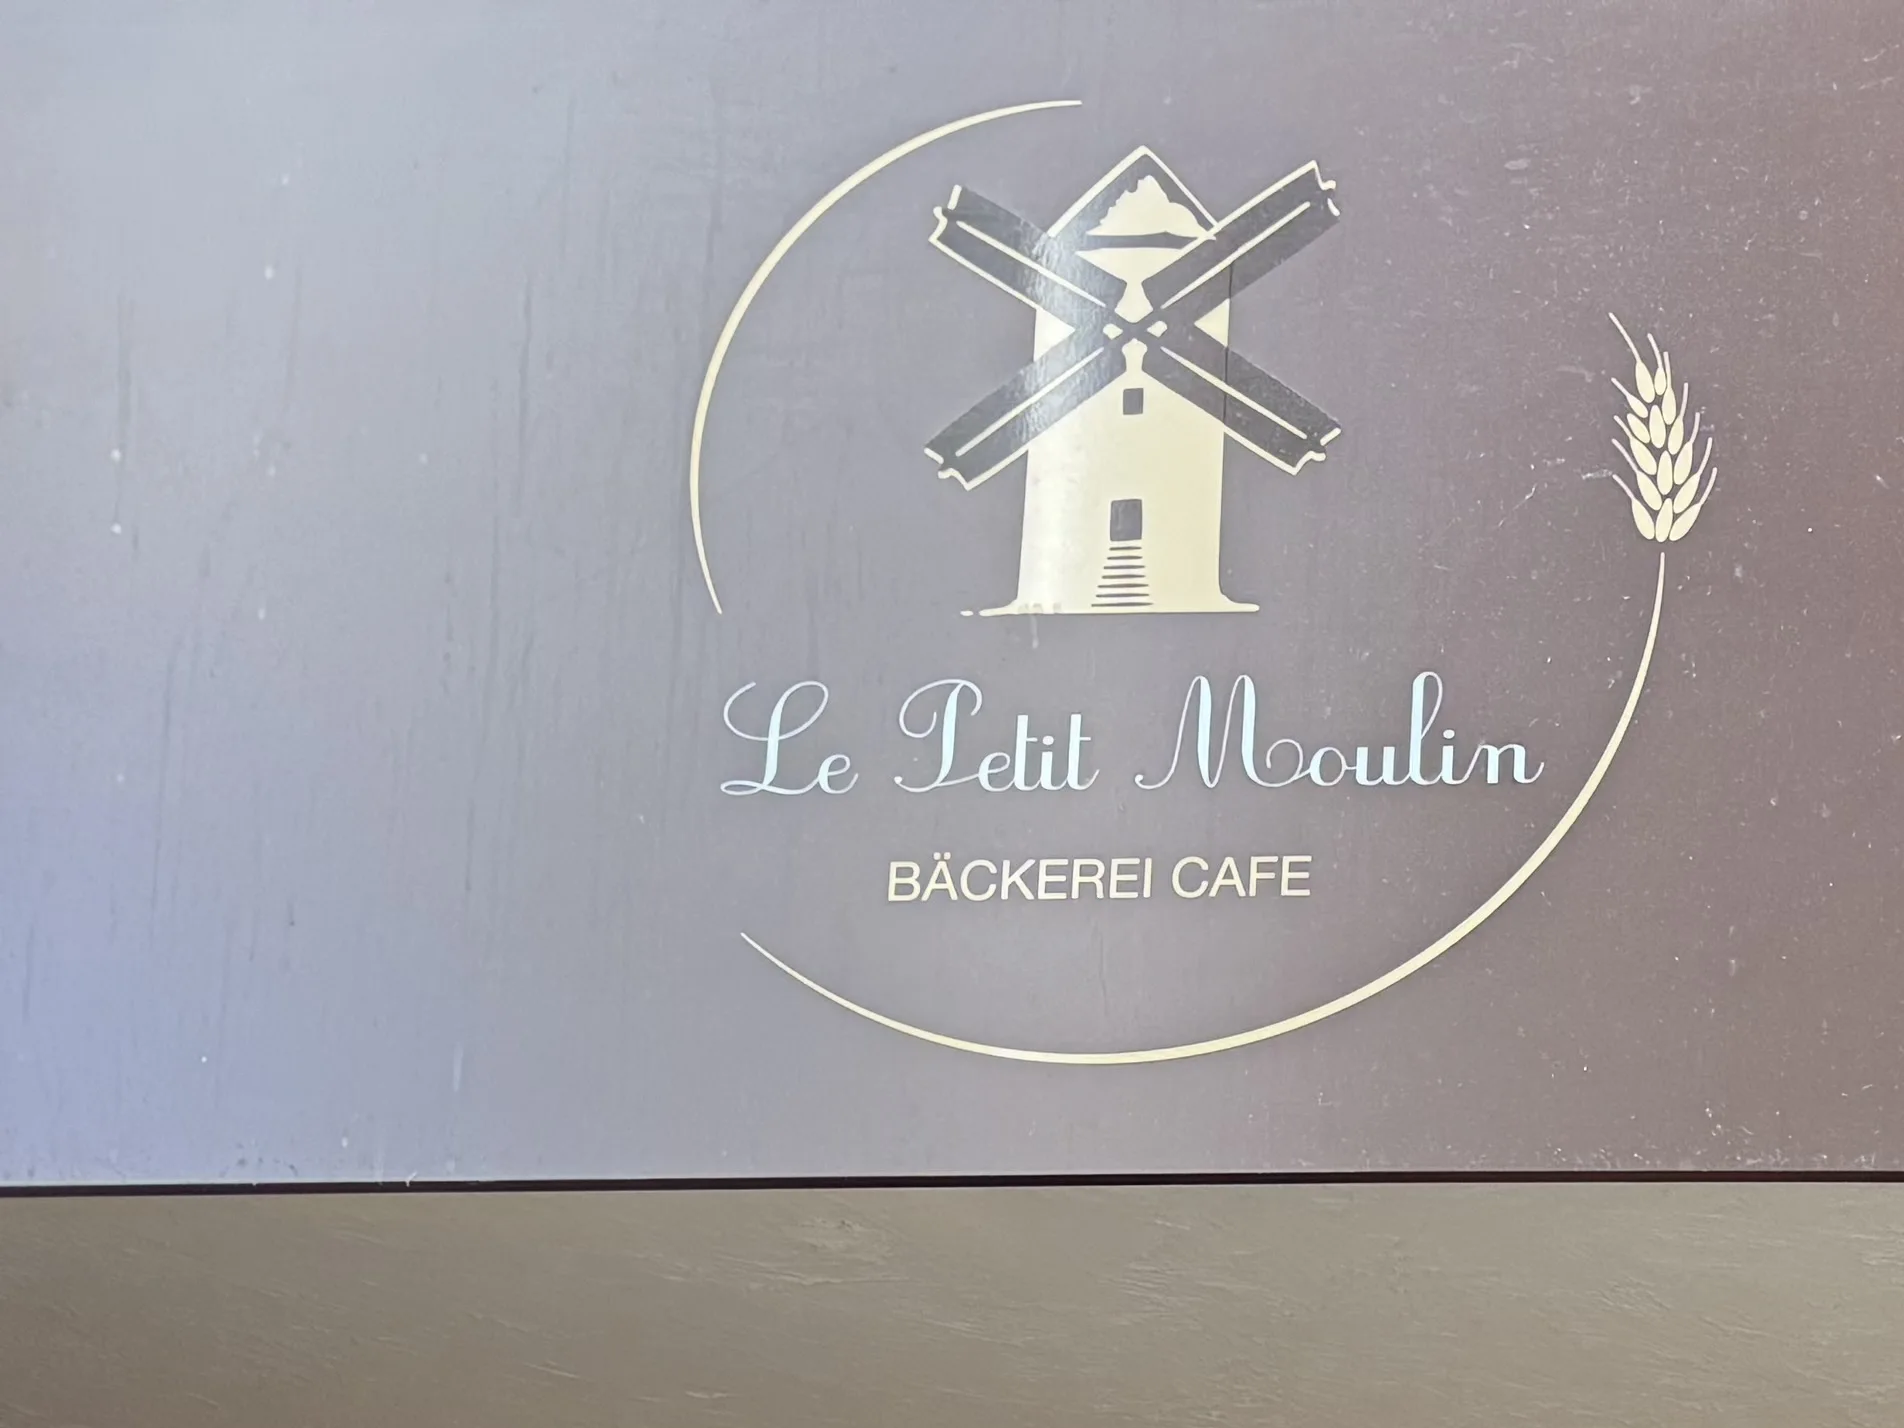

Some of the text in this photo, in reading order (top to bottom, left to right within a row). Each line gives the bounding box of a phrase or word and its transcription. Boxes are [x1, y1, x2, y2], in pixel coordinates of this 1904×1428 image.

[721, 671, 1544, 796] Le Petit Moulin
[887, 852, 1312, 901] BÄCKEREI CAFE
